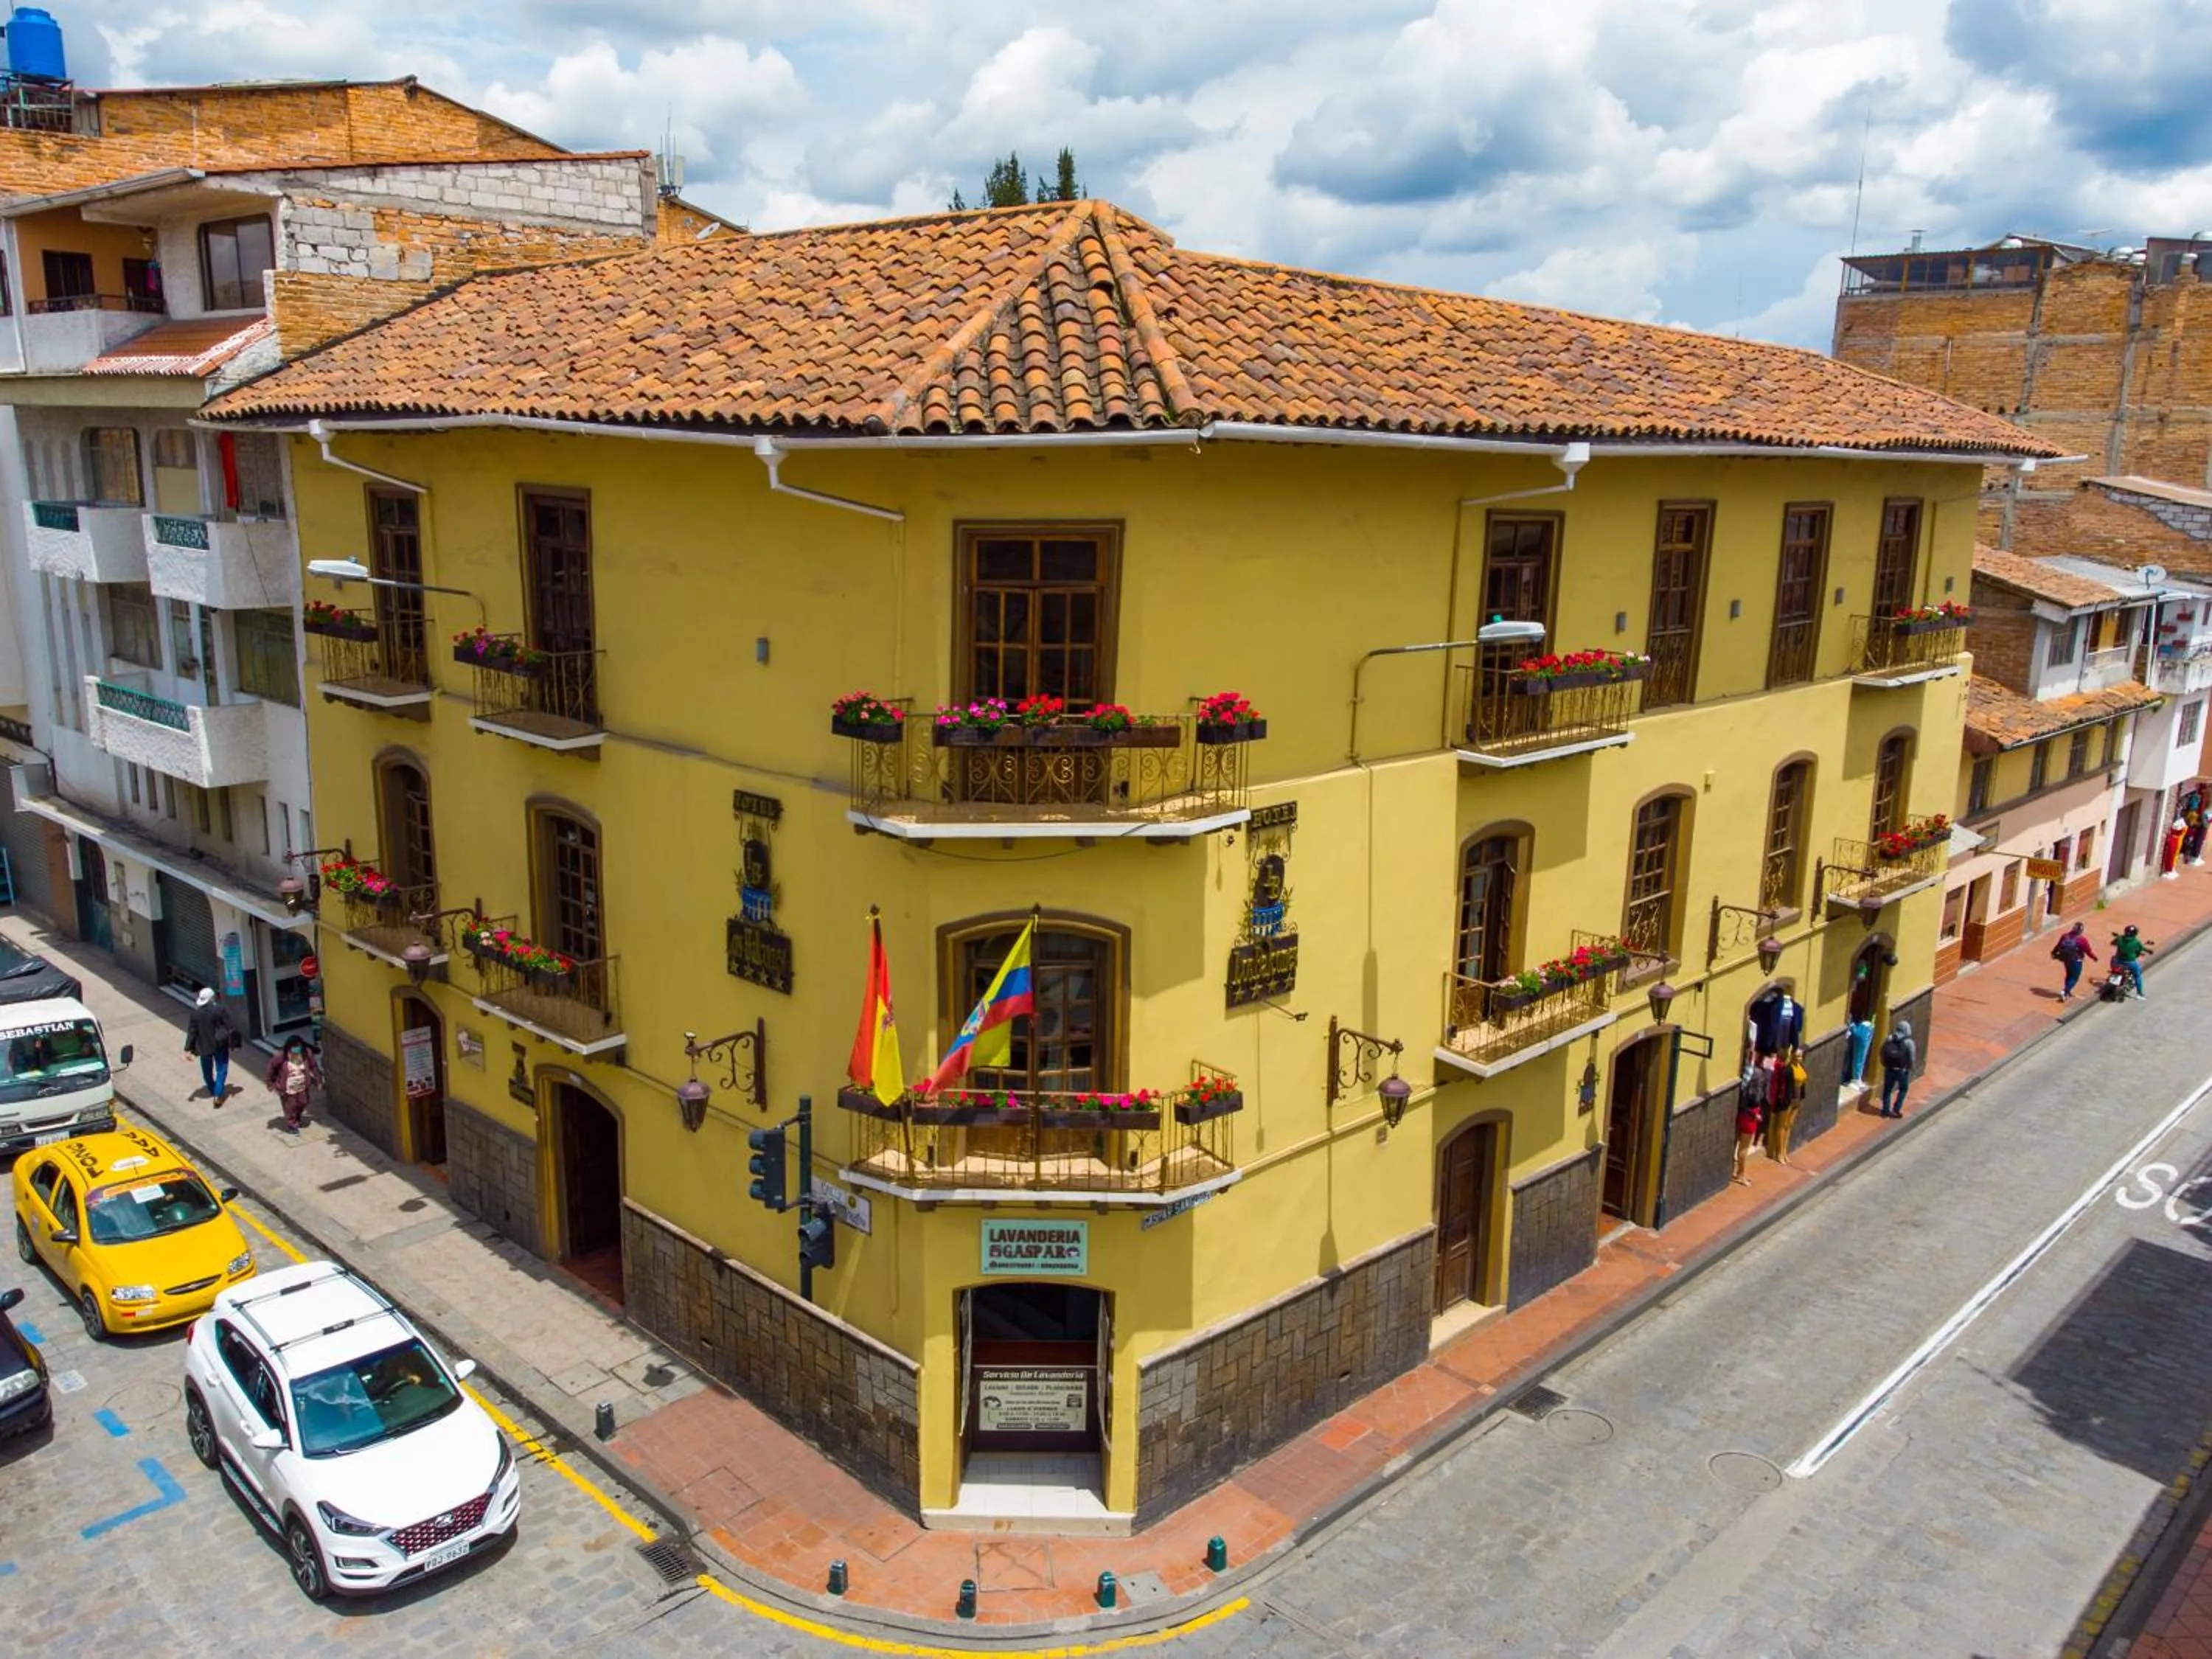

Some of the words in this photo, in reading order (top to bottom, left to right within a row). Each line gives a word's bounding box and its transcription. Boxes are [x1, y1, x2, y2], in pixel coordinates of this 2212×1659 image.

[1253, 804, 1296, 828] HOTEL
[0, 1021, 74, 1040] SEBASTIAN
[990, 1228, 1081, 1243] LAVANDERIA
[1003, 1245, 1065, 1258] GASPAR
[1033, 1371, 1084, 1379] Lavanderia
